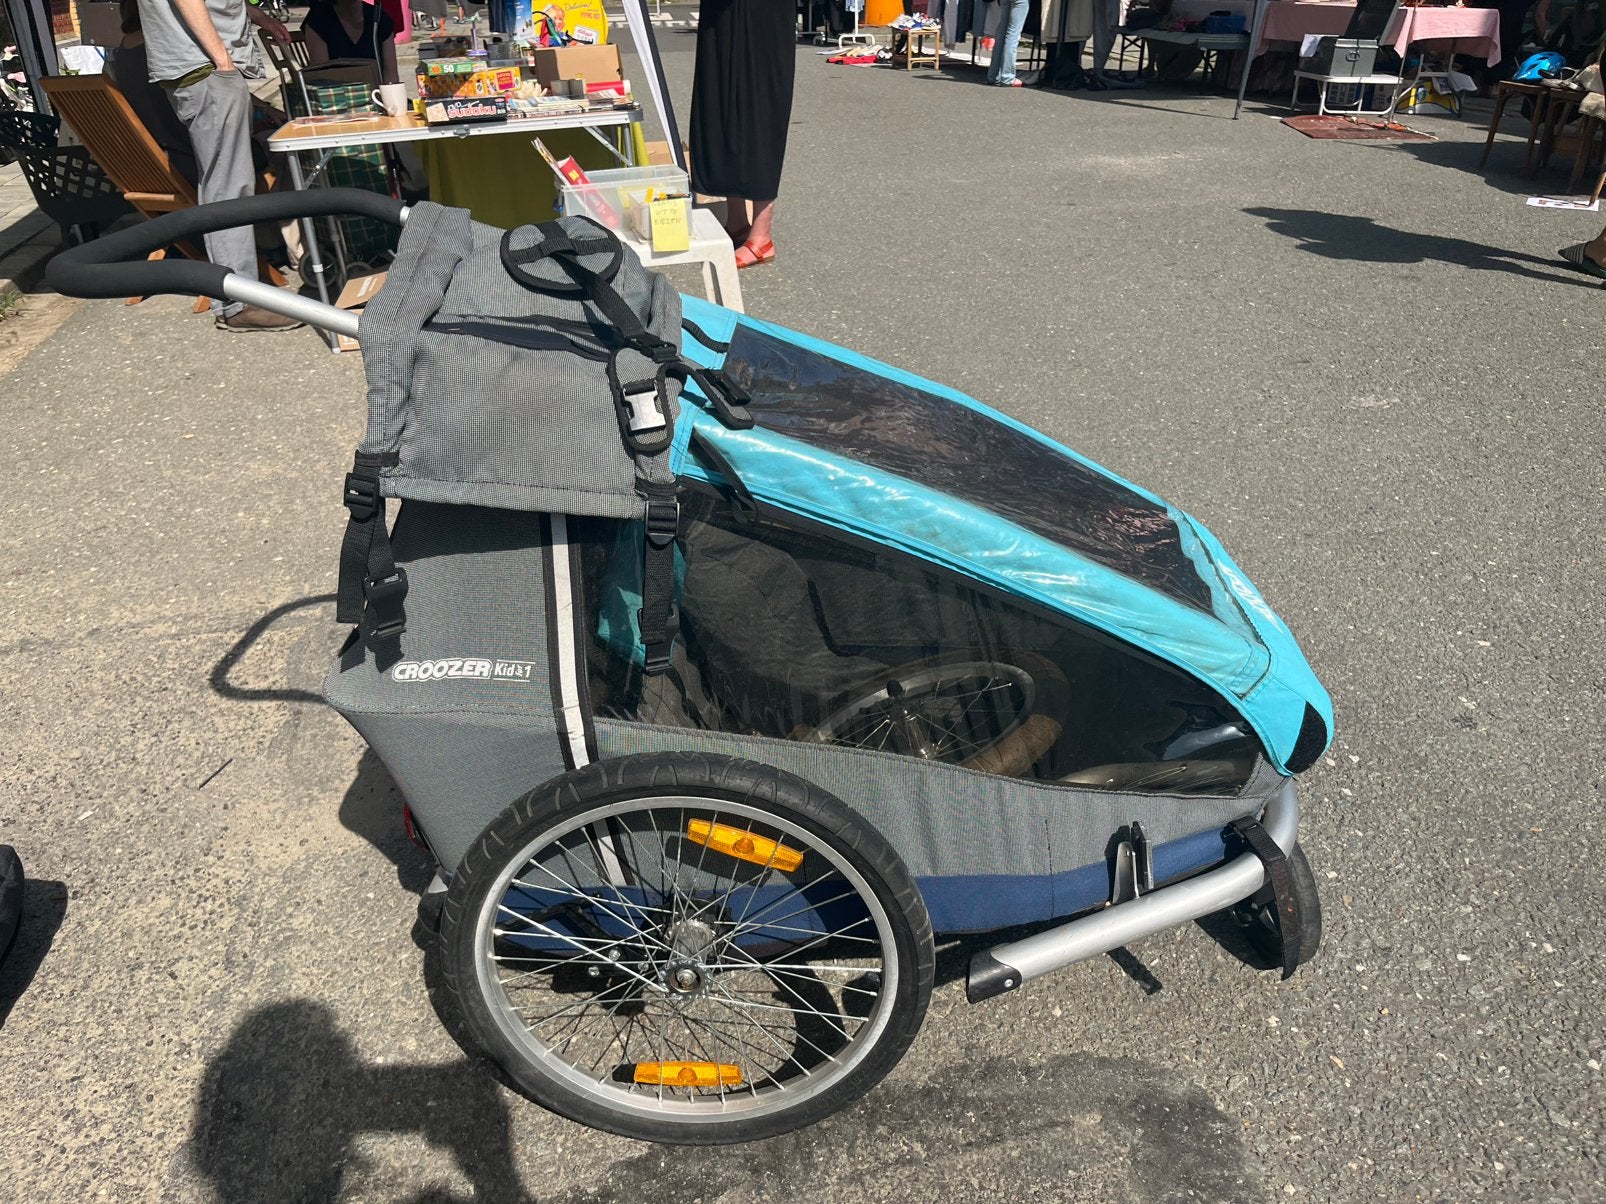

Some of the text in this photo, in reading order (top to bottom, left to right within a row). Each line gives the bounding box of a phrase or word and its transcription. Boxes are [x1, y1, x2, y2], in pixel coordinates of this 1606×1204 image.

[443, 64, 454, 73] 50
[654, 217, 681, 225] KIEZEN
[393, 659, 492, 681] CROOZER
[494, 662, 516, 676] Kid
[524, 665, 532, 678] 1
